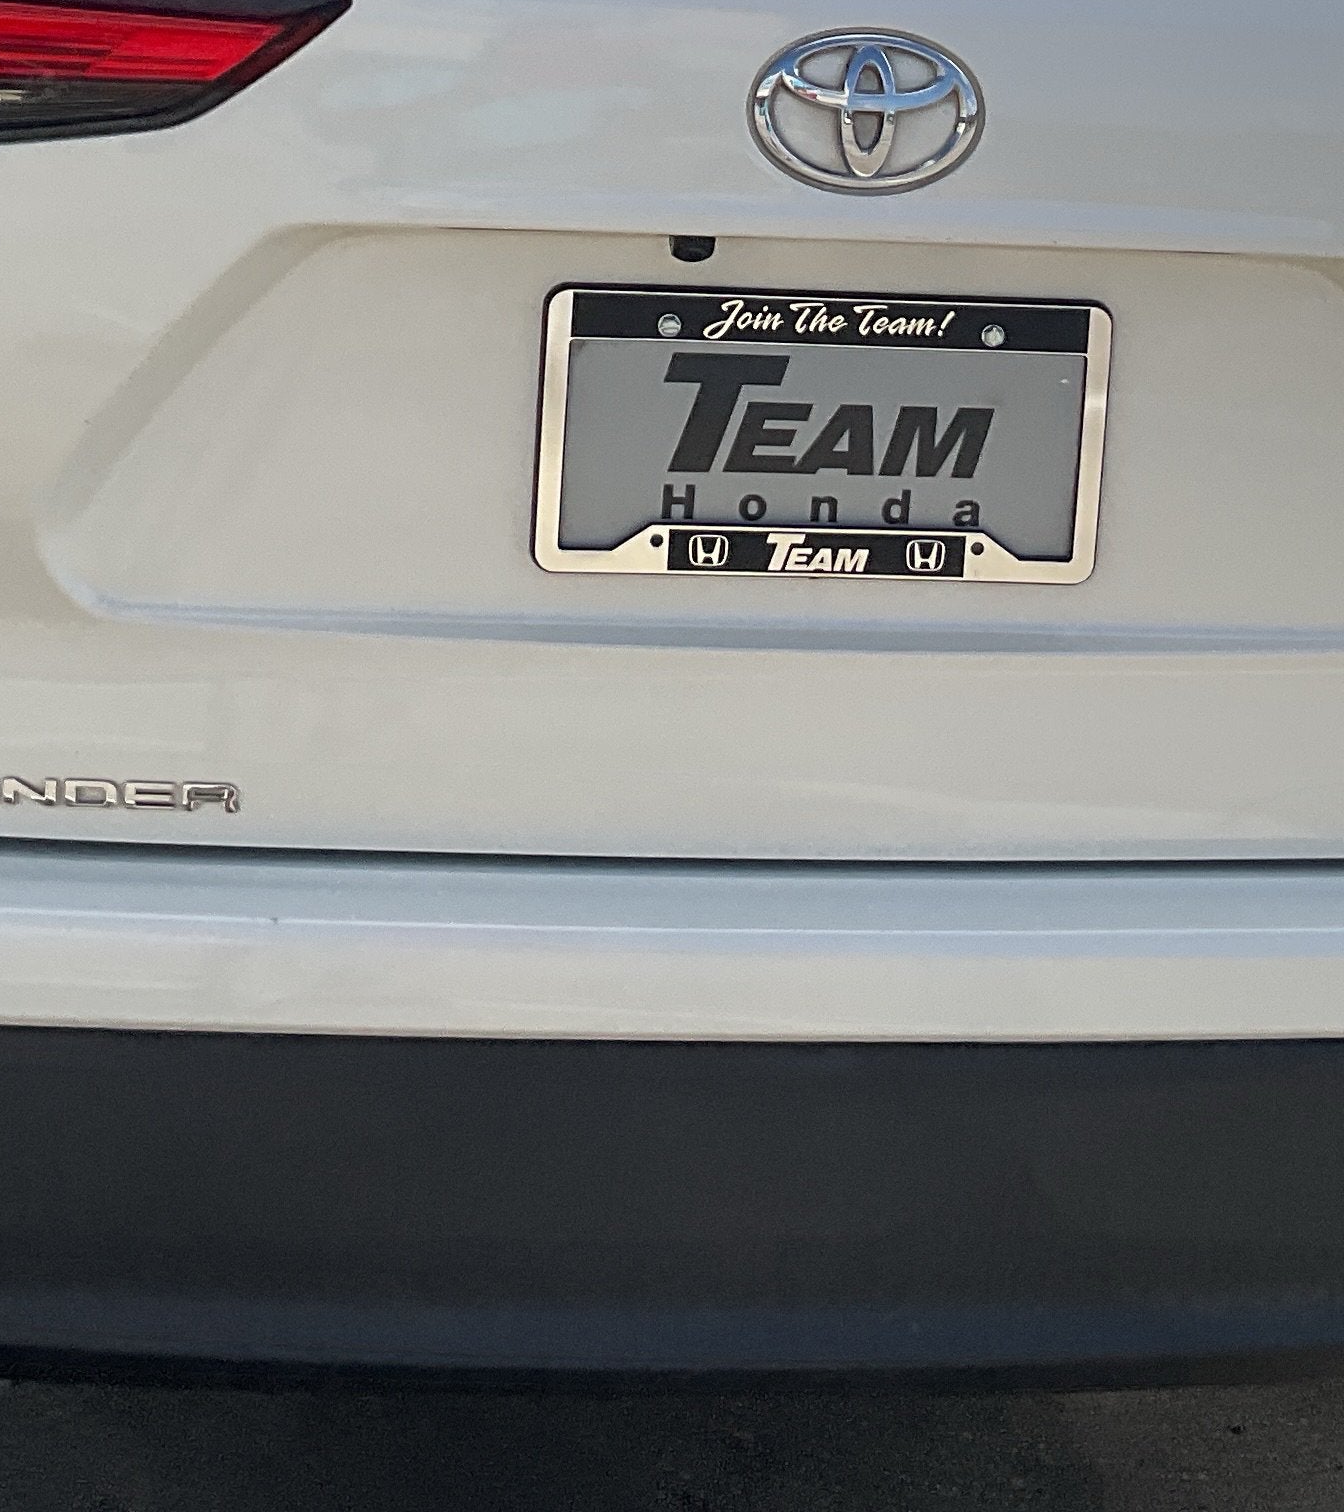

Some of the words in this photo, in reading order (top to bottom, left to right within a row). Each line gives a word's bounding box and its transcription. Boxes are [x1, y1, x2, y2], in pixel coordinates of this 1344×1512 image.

[703, 299, 784, 339] Join
[789, 302, 847, 334] The
[854, 304, 956, 338] Team!
[663, 352, 995, 479] TEAM
[661, 484, 981, 527] Honda
[765, 532, 869, 573] TEAM
